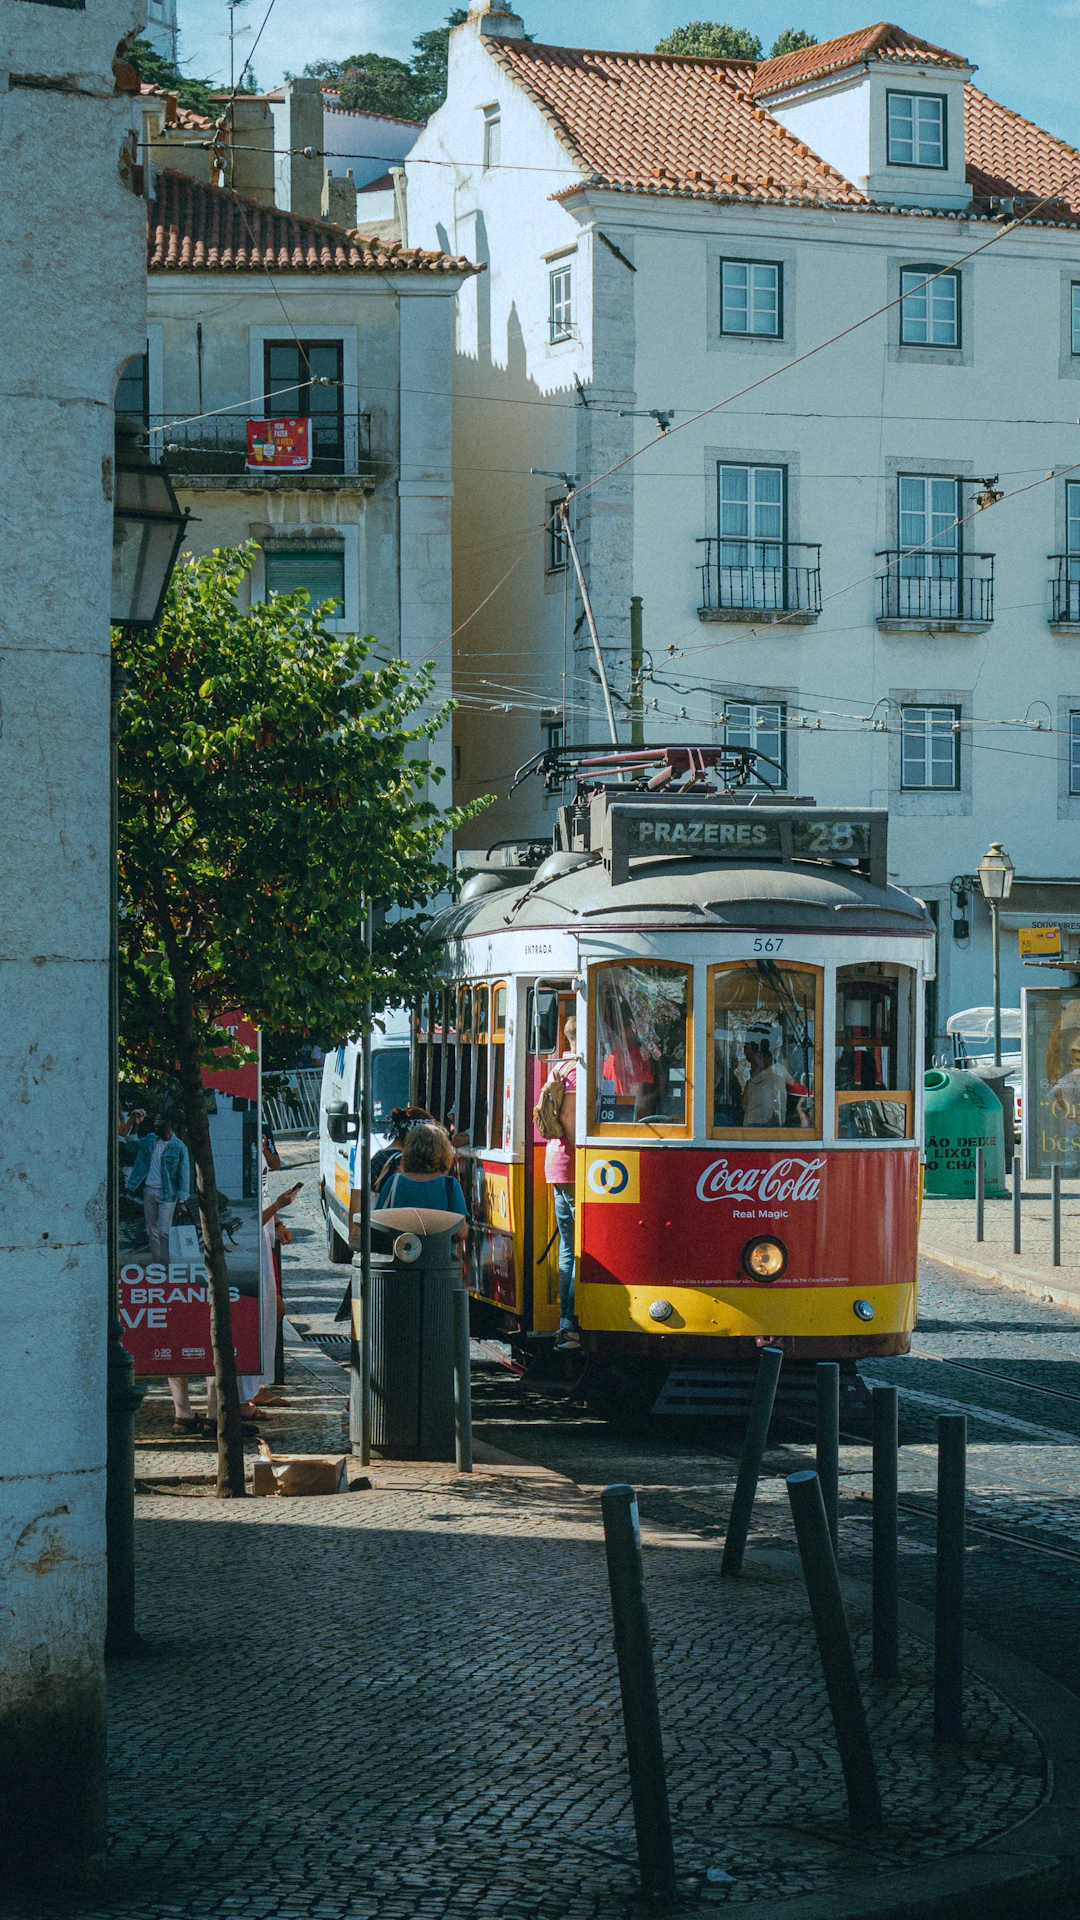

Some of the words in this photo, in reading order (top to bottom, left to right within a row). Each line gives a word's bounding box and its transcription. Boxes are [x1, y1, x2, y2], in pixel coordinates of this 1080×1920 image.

[639, 822, 767, 844] PRAZERES
[808, 821, 856, 851] 28
[524, 944, 552, 955] ENTRADA
[753, 938, 784, 952] 567
[601, 1110, 615, 1121] 08
[924, 1135, 950, 1148] ÃO
[957, 1136, 997, 1147] DEIXE
[934, 1147, 971, 1159] LIXO
[945, 1158, 987, 1171] CHÃ
[696, 1158, 828, 1202] Coca-Cola
[732, 1209, 756, 1219] Real
[758, 1209, 789, 1220] Magic
[118, 1263, 209, 1285] OSER
